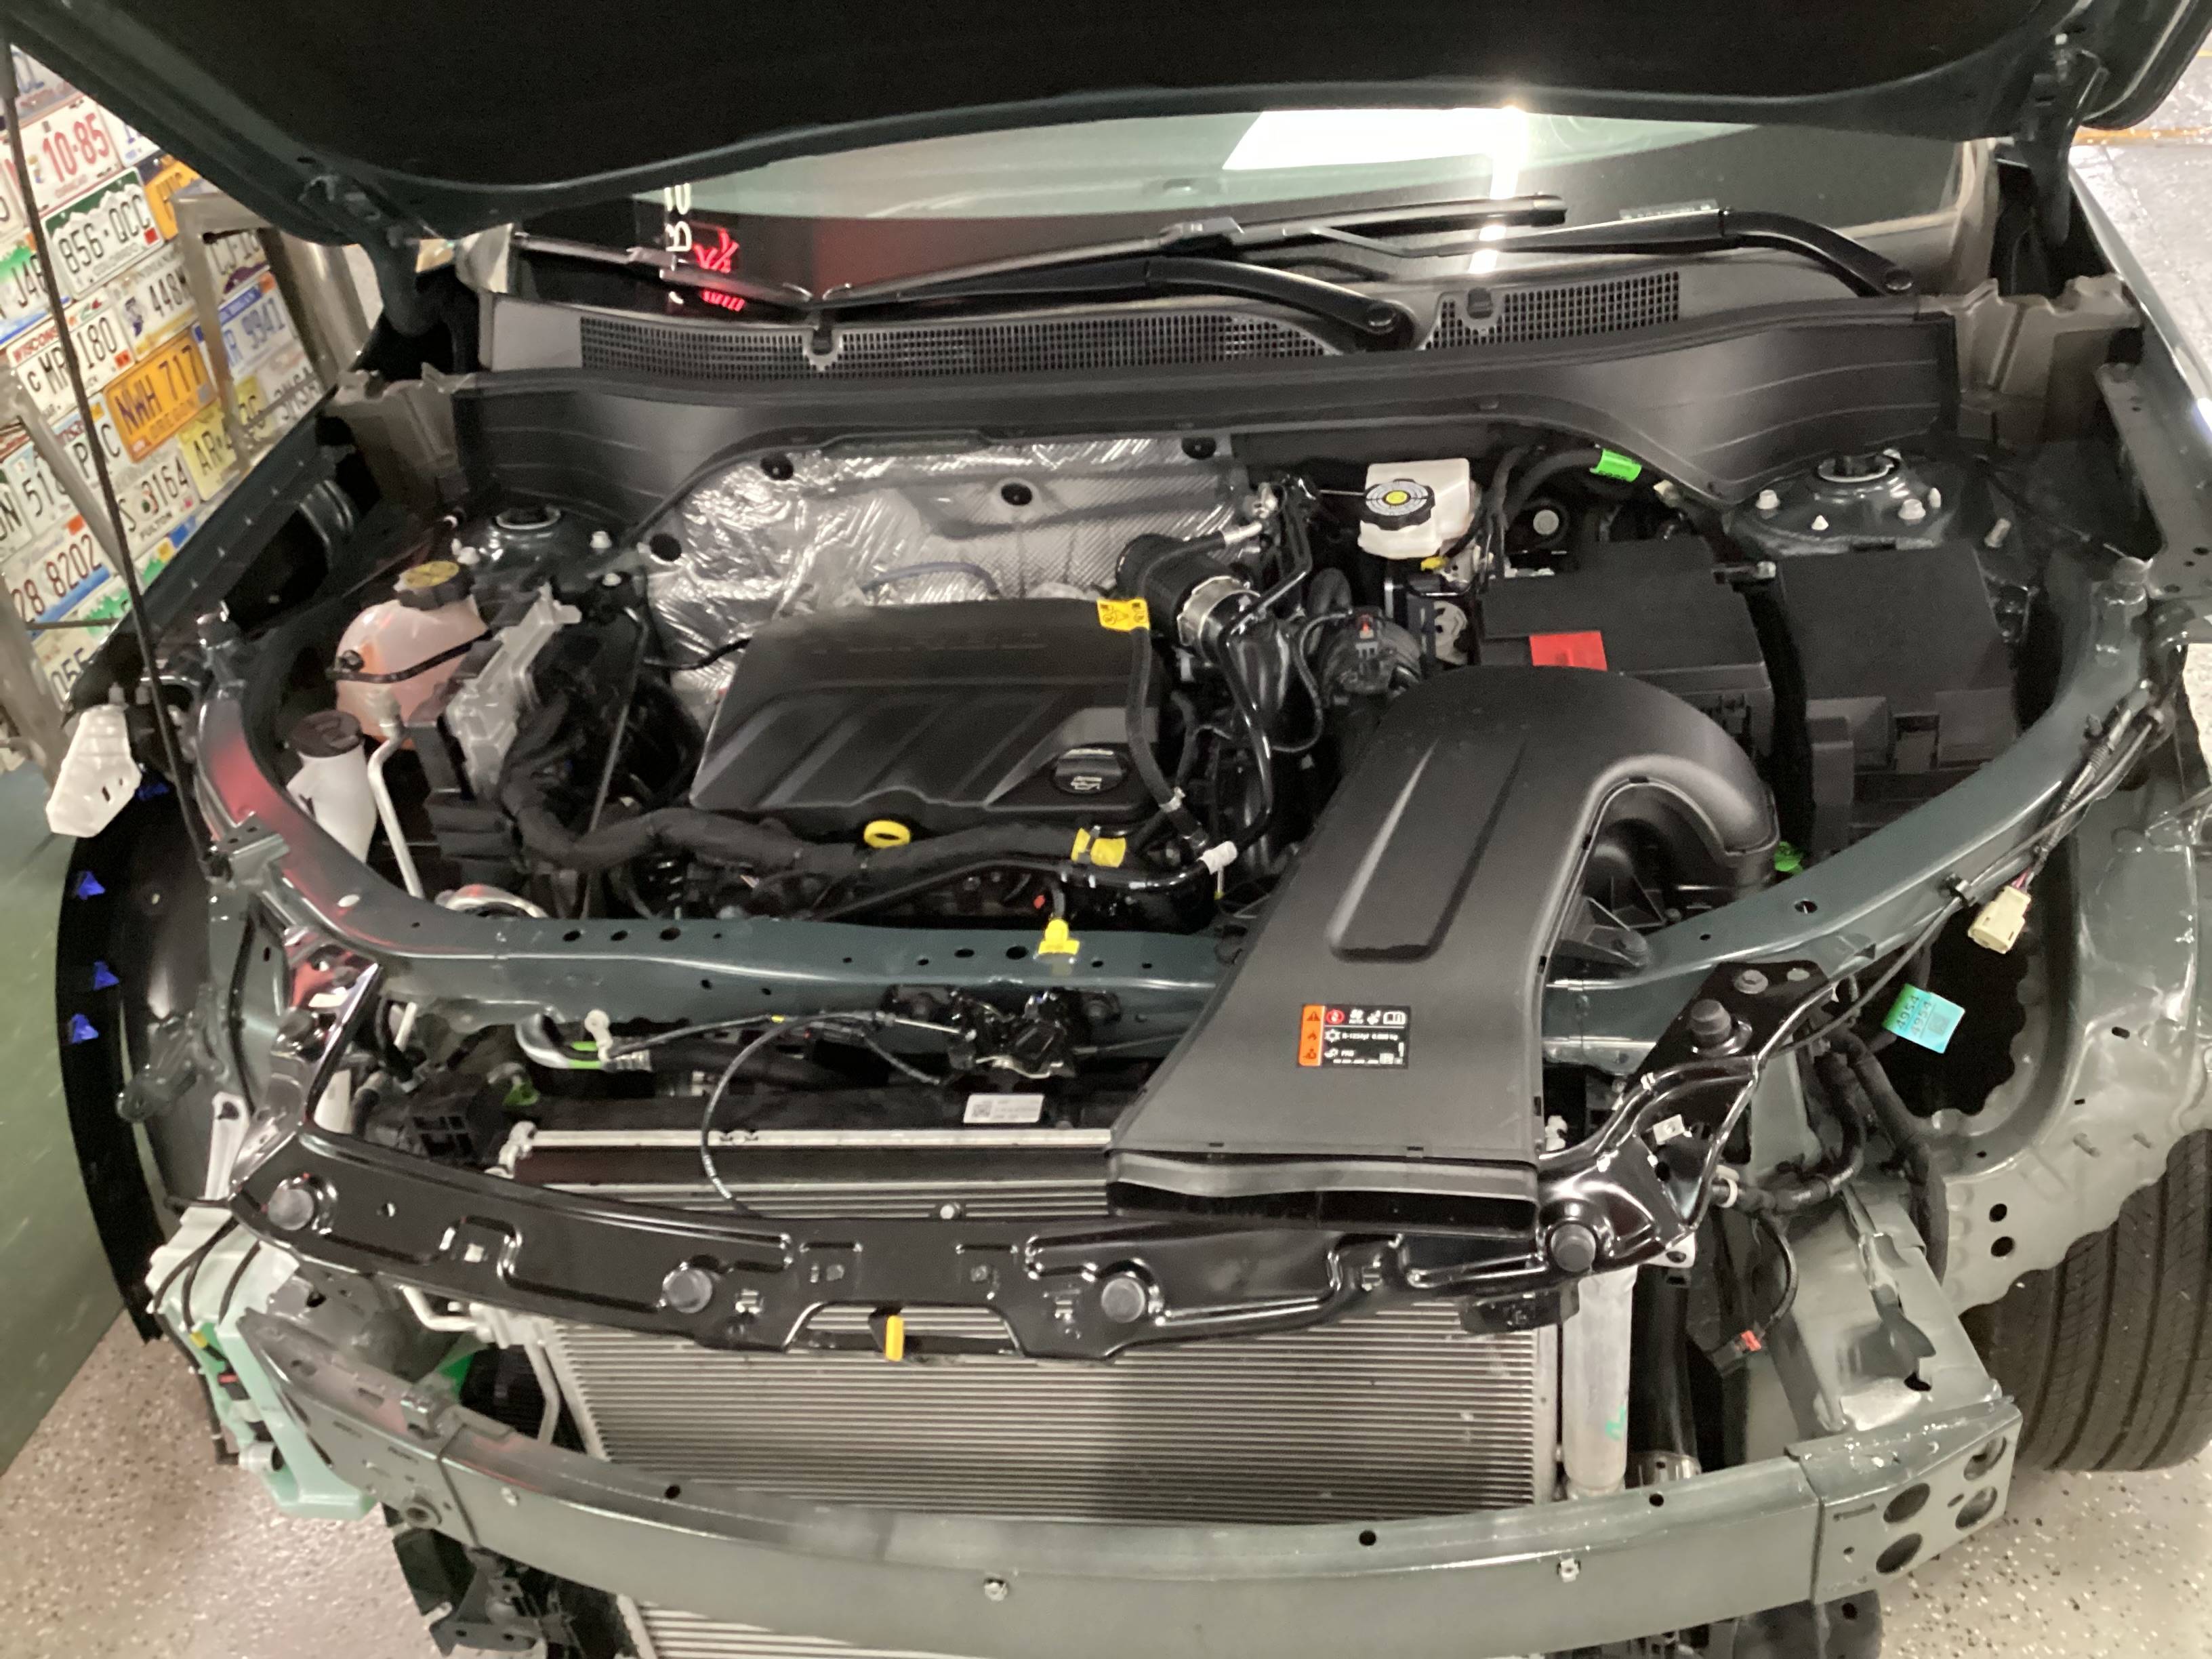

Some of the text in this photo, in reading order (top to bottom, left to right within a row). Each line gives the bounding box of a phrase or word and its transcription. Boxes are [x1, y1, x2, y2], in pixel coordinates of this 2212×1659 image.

[27, 371, 41, 392] C
[77, 317, 117, 369] 180
[158, 344, 201, 402] 717
[45, 533, 102, 598] 8202
[1896, 995, 1919, 1029] 4954
